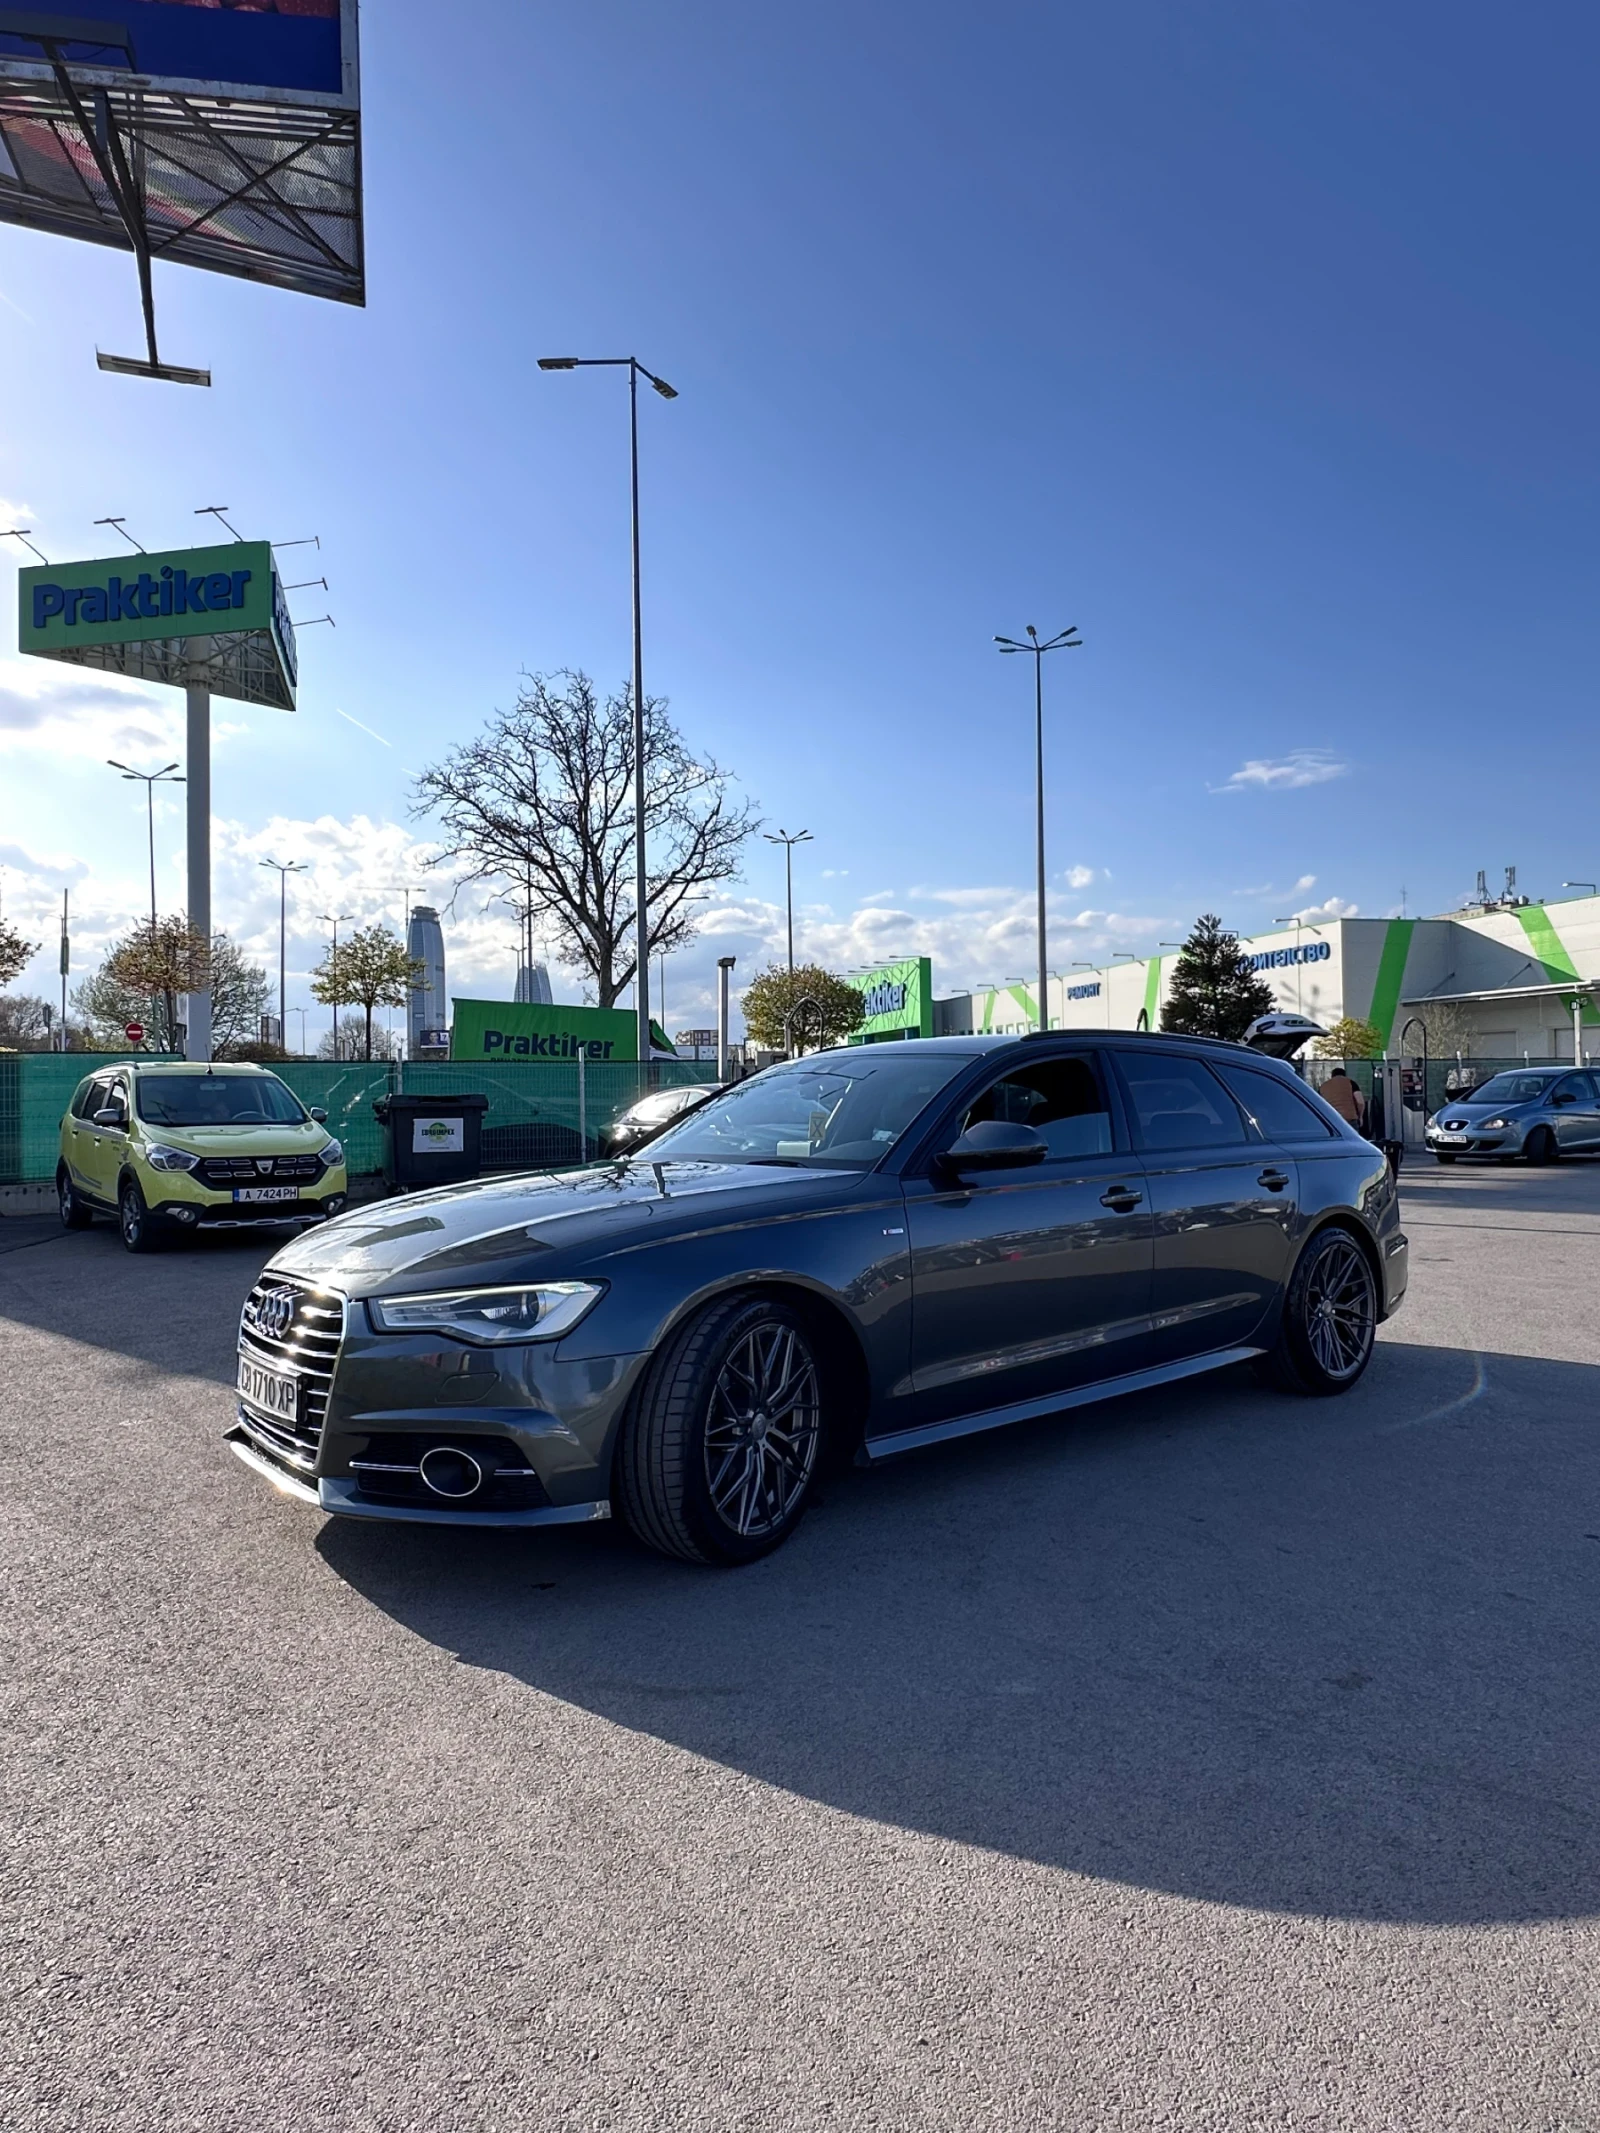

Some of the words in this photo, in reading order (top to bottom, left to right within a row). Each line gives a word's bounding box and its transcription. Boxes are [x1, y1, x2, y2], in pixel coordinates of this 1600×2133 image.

[33, 565, 252, 629] Praktiker
[863, 979, 907, 1017] aktiker
[1067, 982, 1101, 1001] РЕМОНТ
[484, 1030, 614, 1059] Praktiker
[245, 1190, 252, 1200] A
[252, 1368, 276, 1408] 1710
